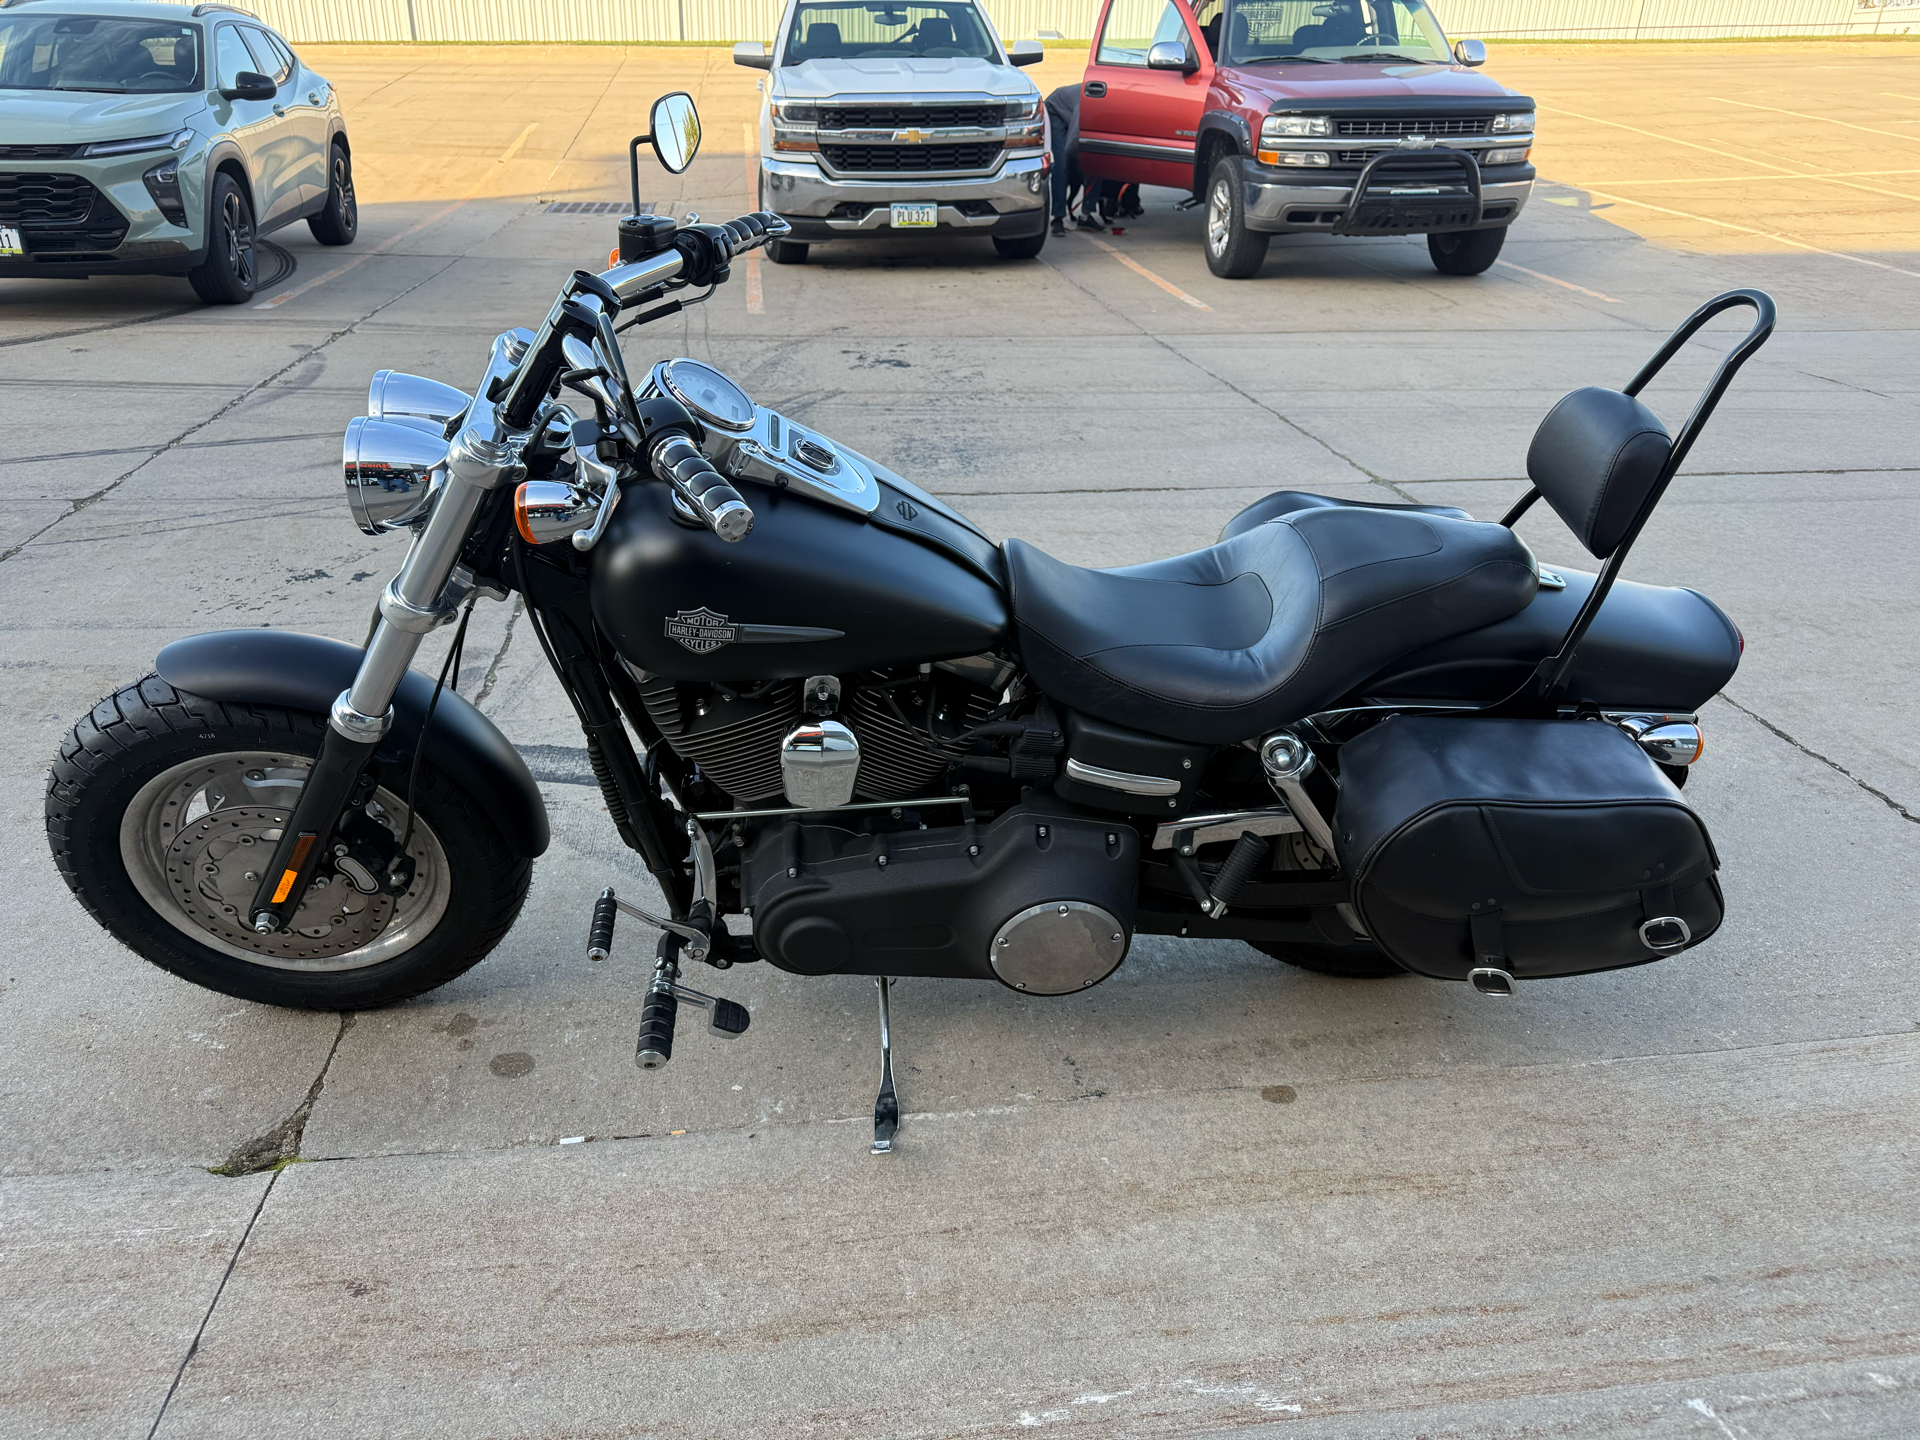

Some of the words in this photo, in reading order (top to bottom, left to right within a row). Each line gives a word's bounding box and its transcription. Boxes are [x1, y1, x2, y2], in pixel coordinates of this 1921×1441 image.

[897, 210, 913, 222] PLU
[915, 210, 930, 222] 321
[686, 615, 720, 627] MOTOR
[671, 624, 732, 639] HARLEY-DAVIDSON
[684, 638, 717, 650] CYCLES
